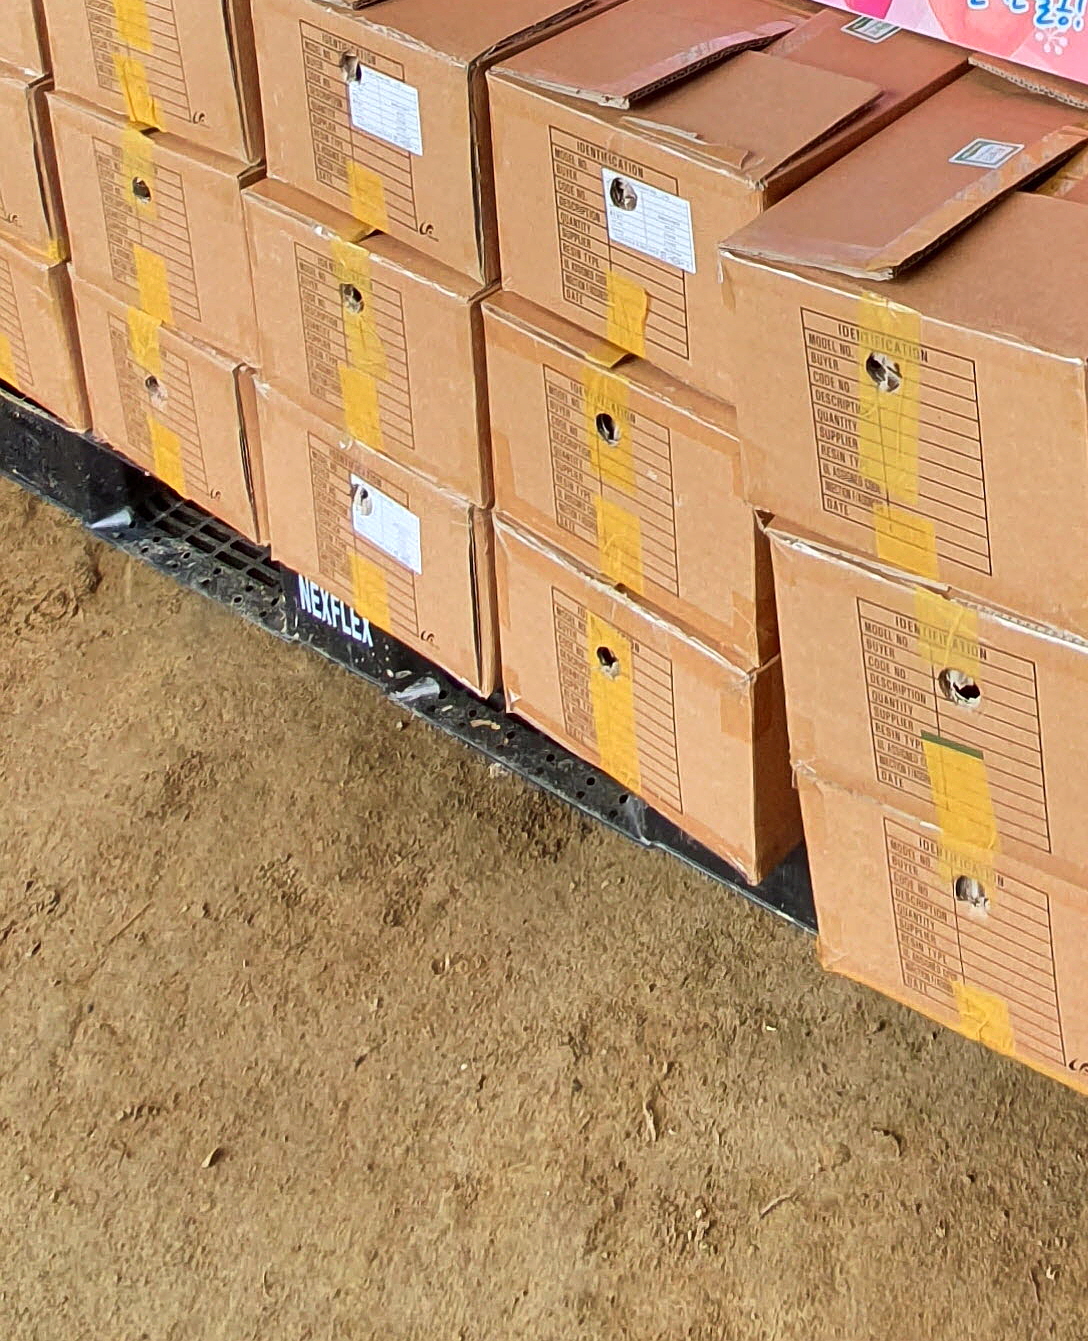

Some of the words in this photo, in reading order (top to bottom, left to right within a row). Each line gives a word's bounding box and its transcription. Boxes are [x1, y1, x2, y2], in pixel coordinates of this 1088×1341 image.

[808, 333, 837, 354] MODEL
[810, 350, 839, 371] BUYER
[813, 369, 836, 388] CODE
[817, 407, 858, 432] QUANTITY
[819, 425, 859, 449] SUPPLIER
[821, 443, 847, 463] RESIN
[826, 497, 849, 516] DATE
[298, 573, 374, 648] NEXFLEX
[864, 621, 893, 644] MODEL
[866, 638, 896, 659] BUYER
[870, 672, 927, 705] DESCRIPTION
[871, 689, 913, 715] QUANTITY
[873, 706, 914, 732] SUPPLIER
